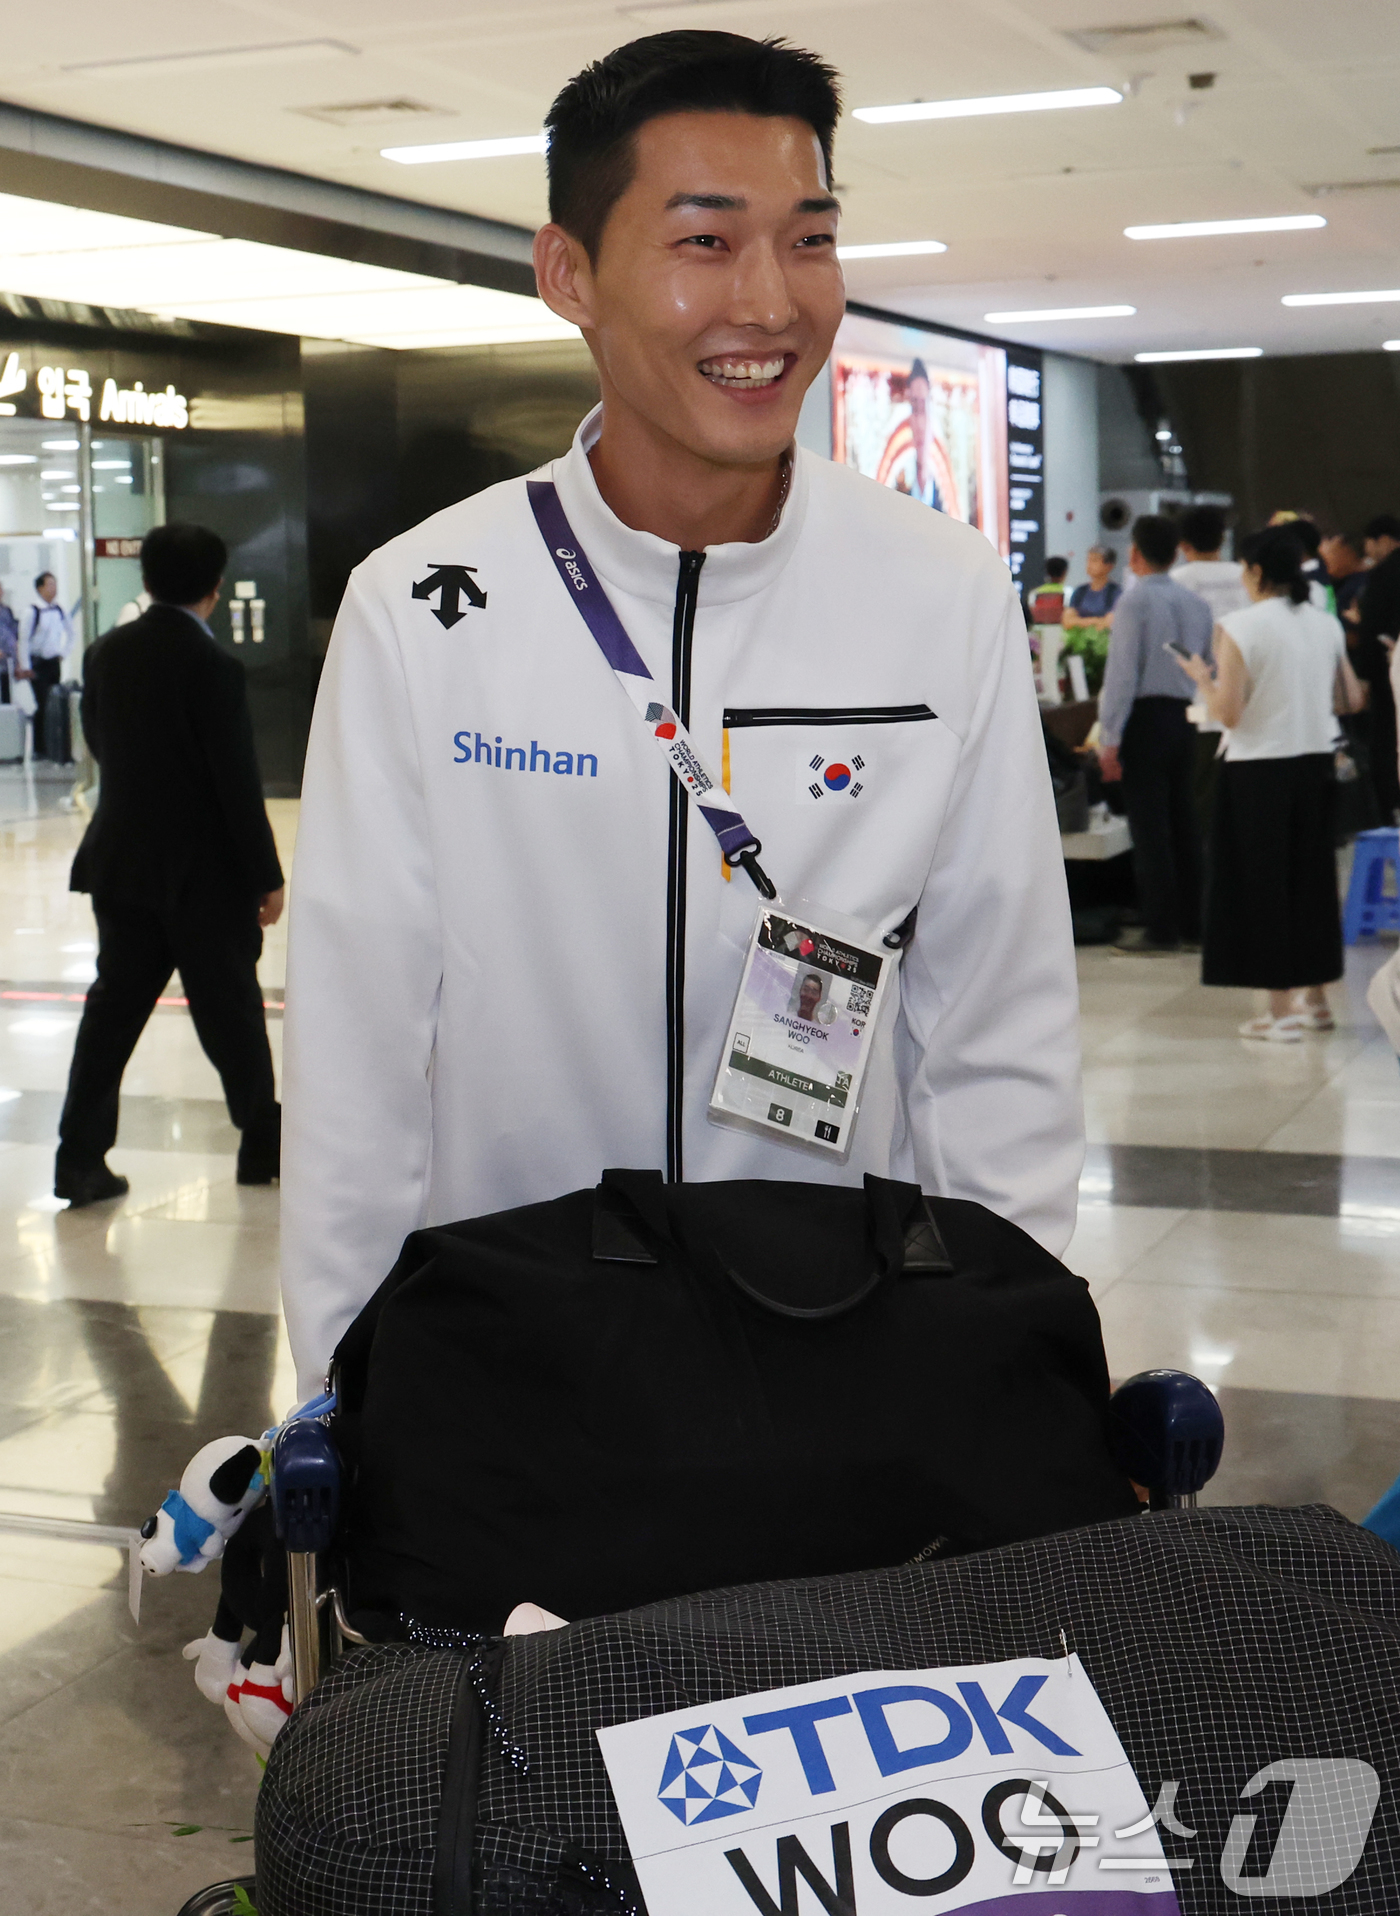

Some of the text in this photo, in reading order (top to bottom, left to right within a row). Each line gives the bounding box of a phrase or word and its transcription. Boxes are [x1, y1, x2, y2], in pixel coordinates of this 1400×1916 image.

[37, 365, 188, 429] 입국 Arrivals
[453, 731, 598, 777] Shinhan
[674, 742, 708, 793] CHAMPIONSHIPS
[680, 739, 713, 790] WORLD ATHLETICS
[737, 1039, 746, 1047] ALL
[773, 1013, 829, 1041] SANGHYEOK
[787, 1029, 810, 1045] WOO
[851, 1017, 866, 1028] KOR
[775, 1108, 785, 1122] 8
[742, 1675, 1084, 1795] TDK
[724, 1778, 1080, 1916] WOO
